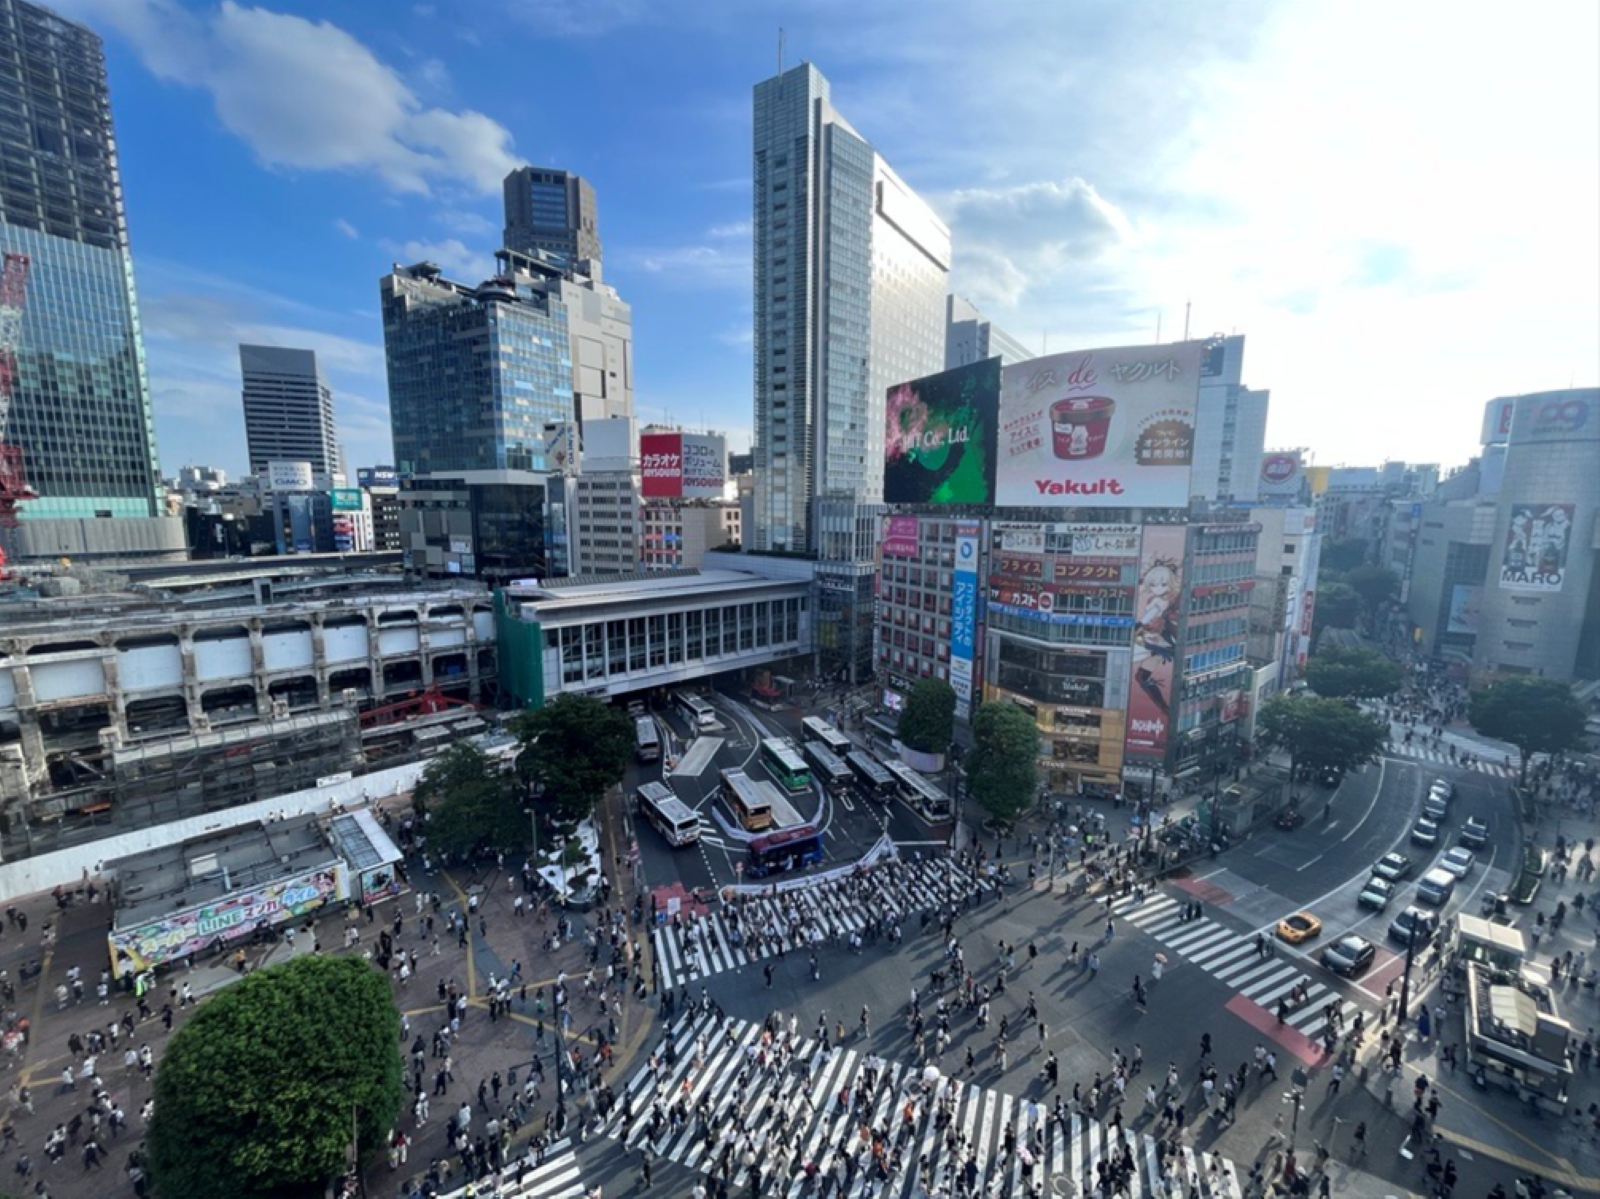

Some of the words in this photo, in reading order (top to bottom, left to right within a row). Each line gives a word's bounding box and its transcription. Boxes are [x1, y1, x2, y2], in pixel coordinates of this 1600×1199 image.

[1067, 354, 1099, 385] de
[1111, 359, 1180, 383] ヤクルト
[1144, 437, 1190, 447] オンライン
[683, 444, 715, 456] ココロの
[643, 454, 680, 467] カラオケ
[274, 477, 308, 486] GMO
[1034, 478, 1126, 496] Yakult
[1055, 565, 1119, 578] コンタクト
[1501, 570, 1562, 586] MARO
[1012, 592, 1038, 607] ガスト
[199, 913, 243, 936] LINE
[243, 899, 280, 920] マンガ
